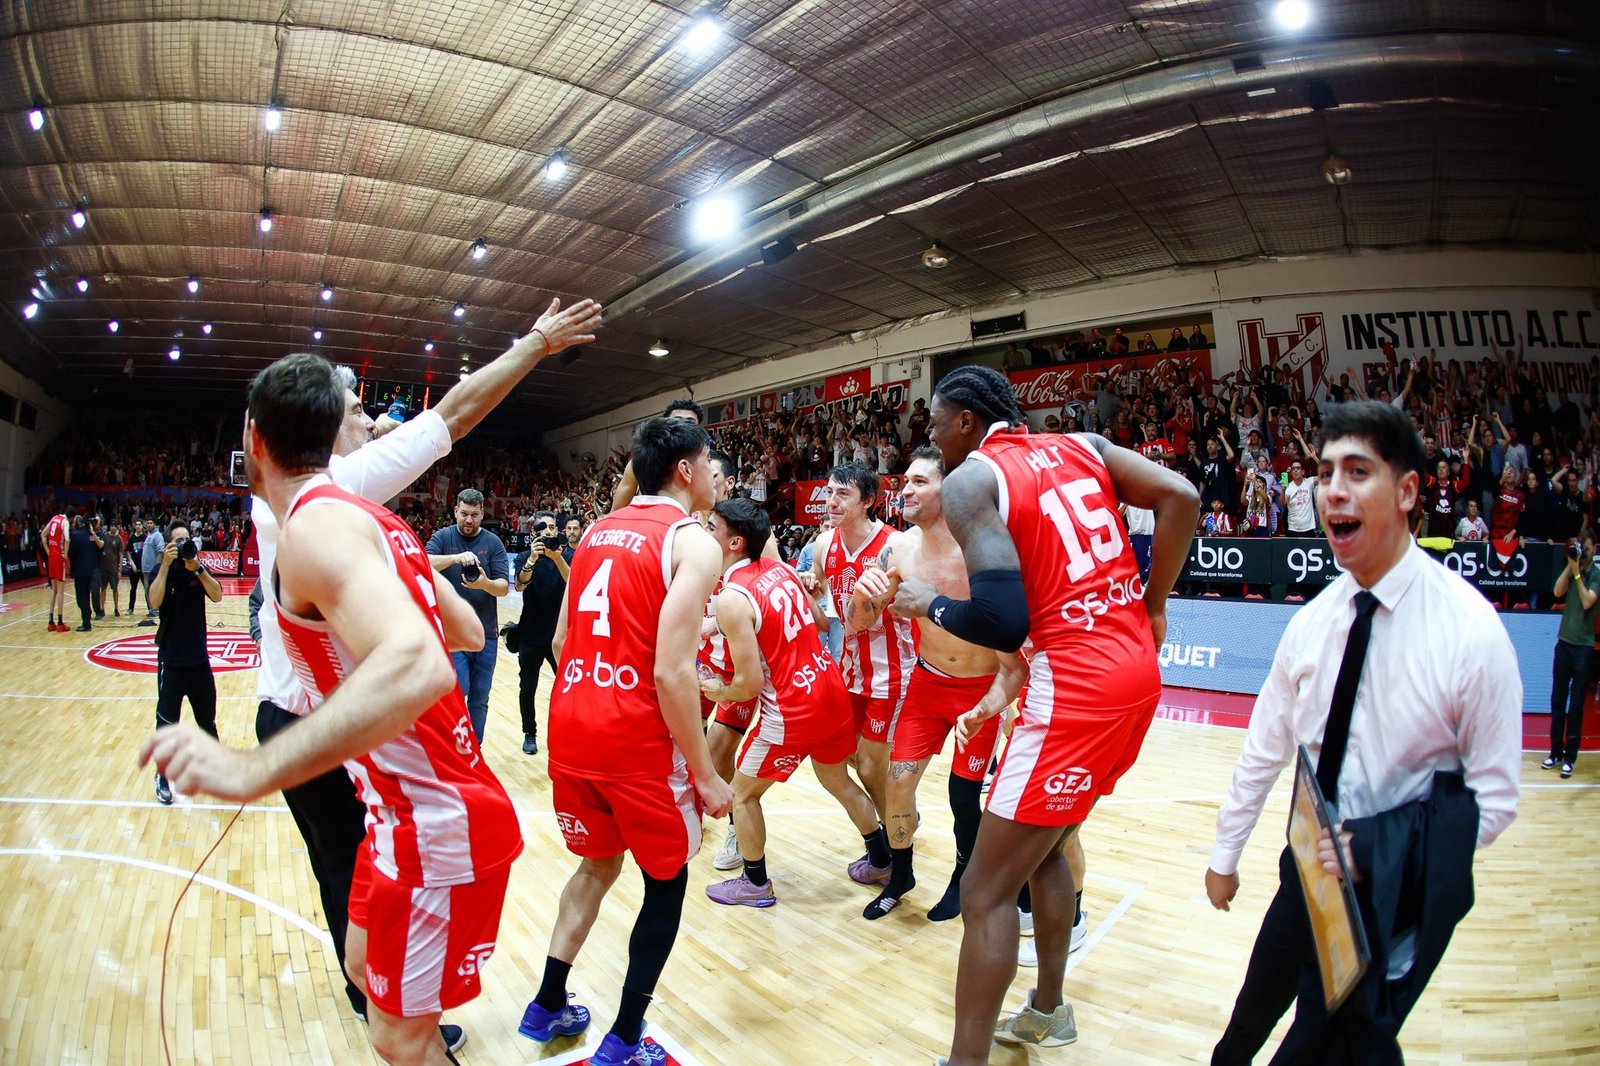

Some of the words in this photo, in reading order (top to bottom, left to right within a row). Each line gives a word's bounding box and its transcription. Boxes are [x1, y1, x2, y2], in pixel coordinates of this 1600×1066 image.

[1342, 310, 1516, 350] INSTITUTO
[50, 523, 57, 537] 9
[587, 529, 647, 555] NEGRETE
[1039, 477, 1124, 584] 15
[577, 558, 614, 638] 4
[769, 579, 816, 644] 22
[1158, 643, 1222, 668] QUET
[1043, 773, 1093, 795] GEA
[1056, 803, 1074, 812] salud
